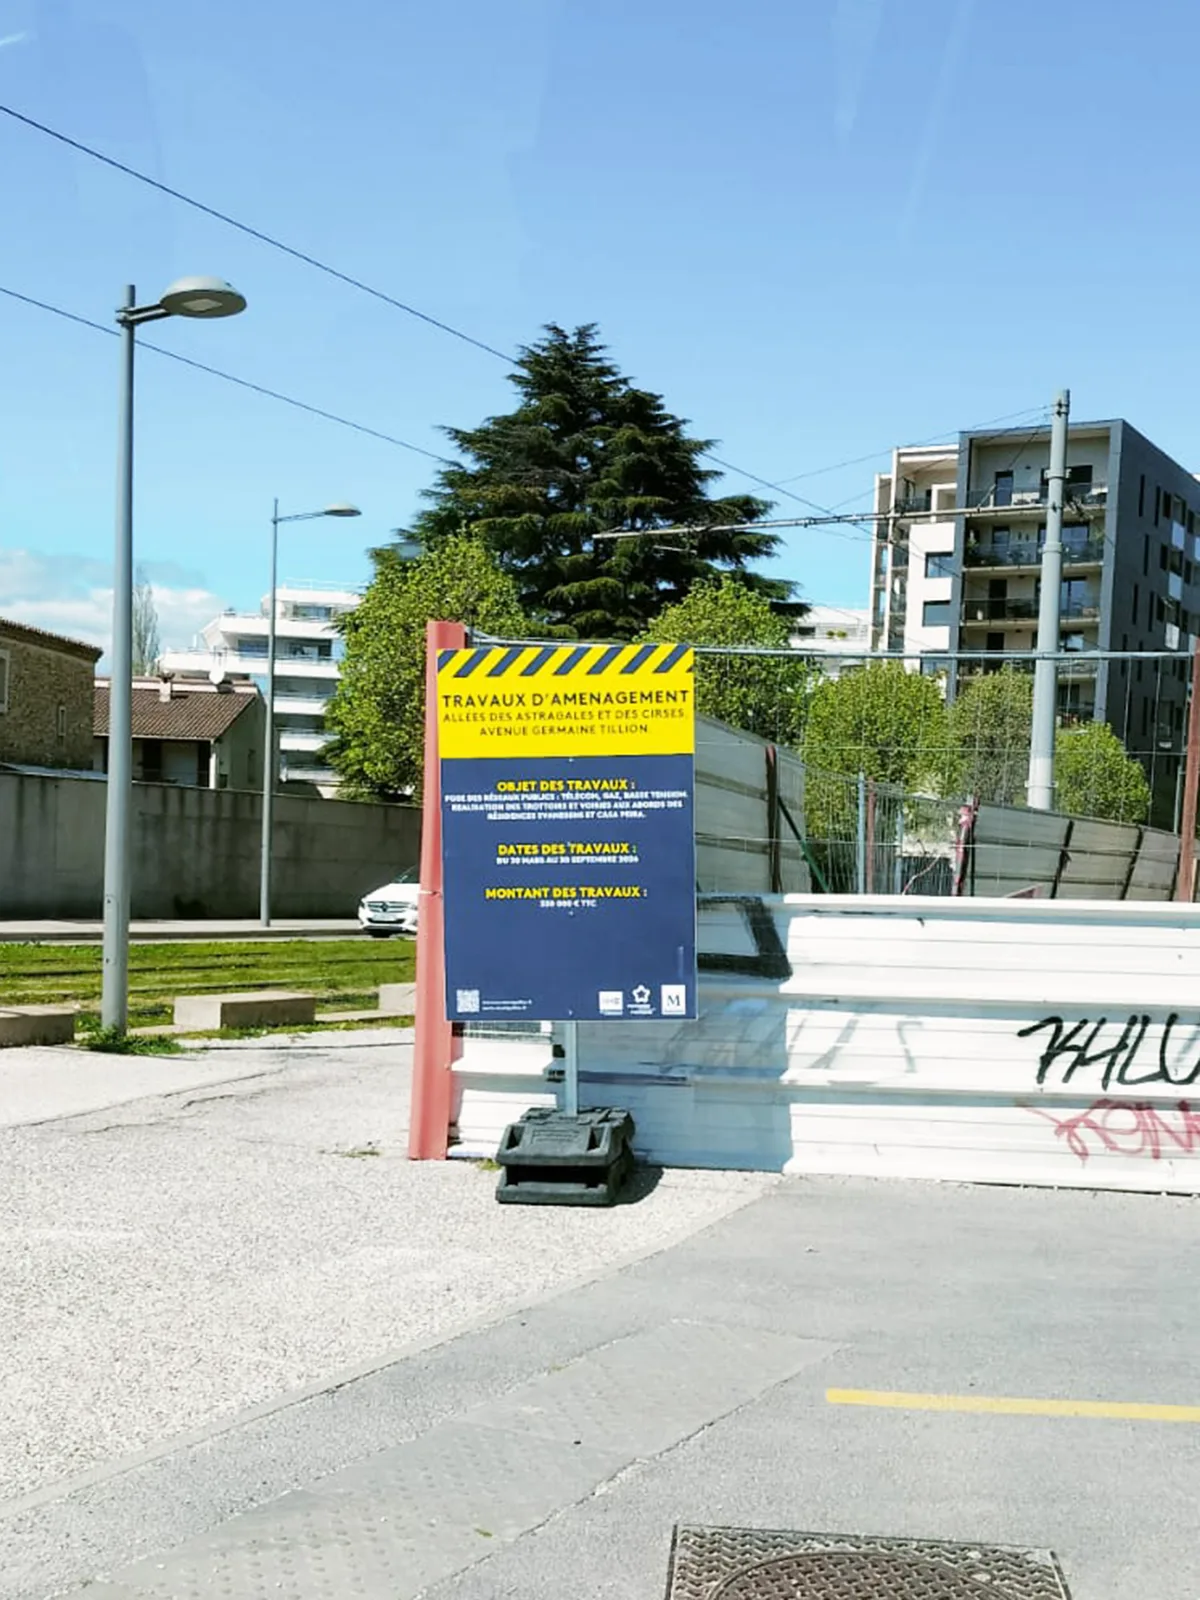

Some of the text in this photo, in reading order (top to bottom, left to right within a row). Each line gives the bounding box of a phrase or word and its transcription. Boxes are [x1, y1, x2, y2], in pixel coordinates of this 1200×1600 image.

[443, 690, 689, 707] TRAVAUX D'AMENAGEMENT
[490, 711, 512, 721] DES
[516, 710, 594, 721] ASTRAGALES
[598, 709, 611, 719] ET
[615, 709, 637, 719] DES
[480, 727, 528, 736] AVENUE
[532, 725, 596, 735] GERMAINE
[497, 781, 537, 791] OBJET
[541, 781, 564, 791] DES
[567, 779, 628, 790] TRAVAUX
[498, 844, 539, 856] DATES
[542, 844, 566, 854] DES
[569, 843, 629, 854] TRAVAUX
[485, 888, 549, 899] MONTANT
[552, 888, 576, 898] DES
[580, 887, 640, 897] TRAVAUX
[667, 995, 680, 1006] M
